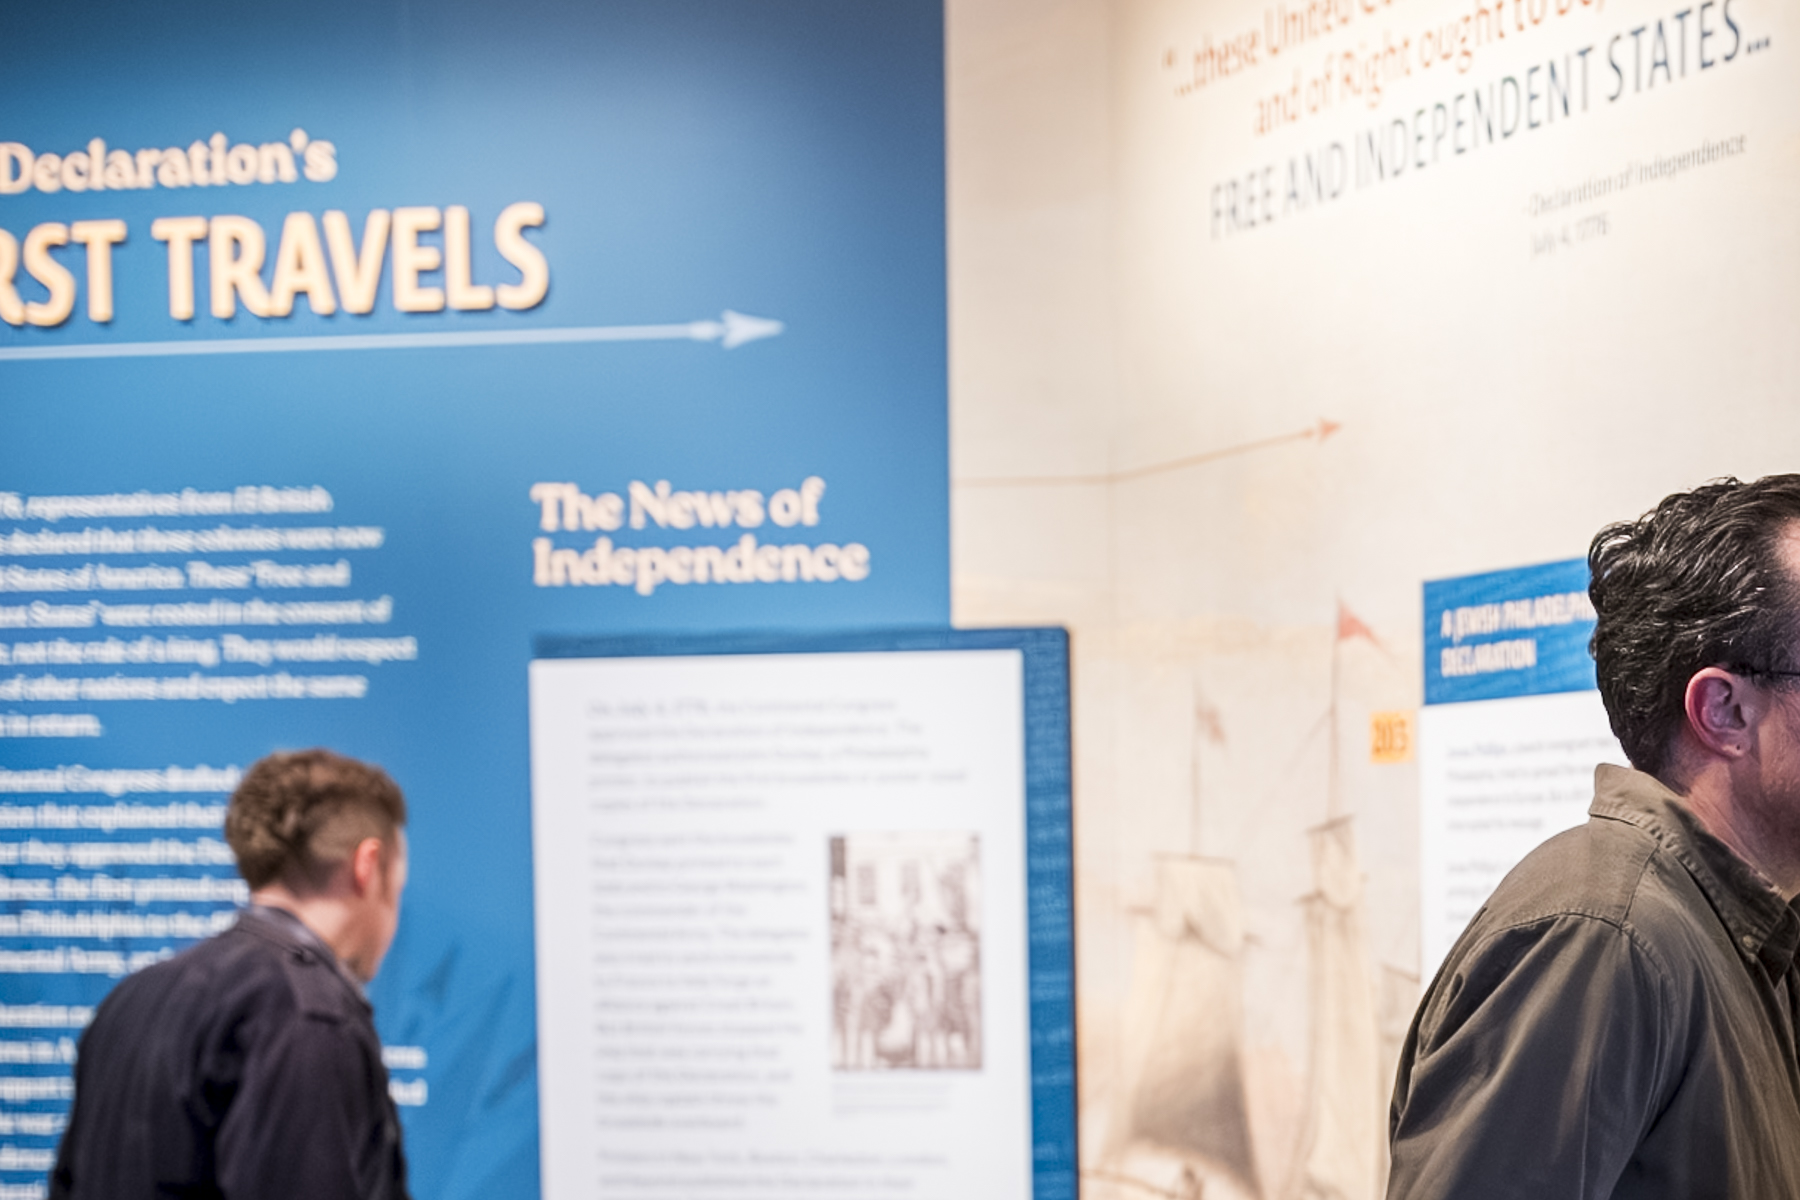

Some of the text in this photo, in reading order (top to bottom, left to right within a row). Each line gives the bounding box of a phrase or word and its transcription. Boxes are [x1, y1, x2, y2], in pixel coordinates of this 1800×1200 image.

[1254, 68, 1300, 137] and
[1304, 52, 1334, 115] of
[1340, 30, 1412, 110] Right
[1419, 0, 1505, 74] ought
[0, 128, 338, 195] Declaration's
[1211, 162, 1275, 239] FREE
[1283, 139, 1343, 210] AND
[1355, 46, 1594, 193] INDEPENDENT
[151, 200, 550, 321] TRAVELS
[530, 475, 824, 533] The News of
[533, 532, 872, 597] Independence
[1440, 638, 1536, 678] DECLARATION
